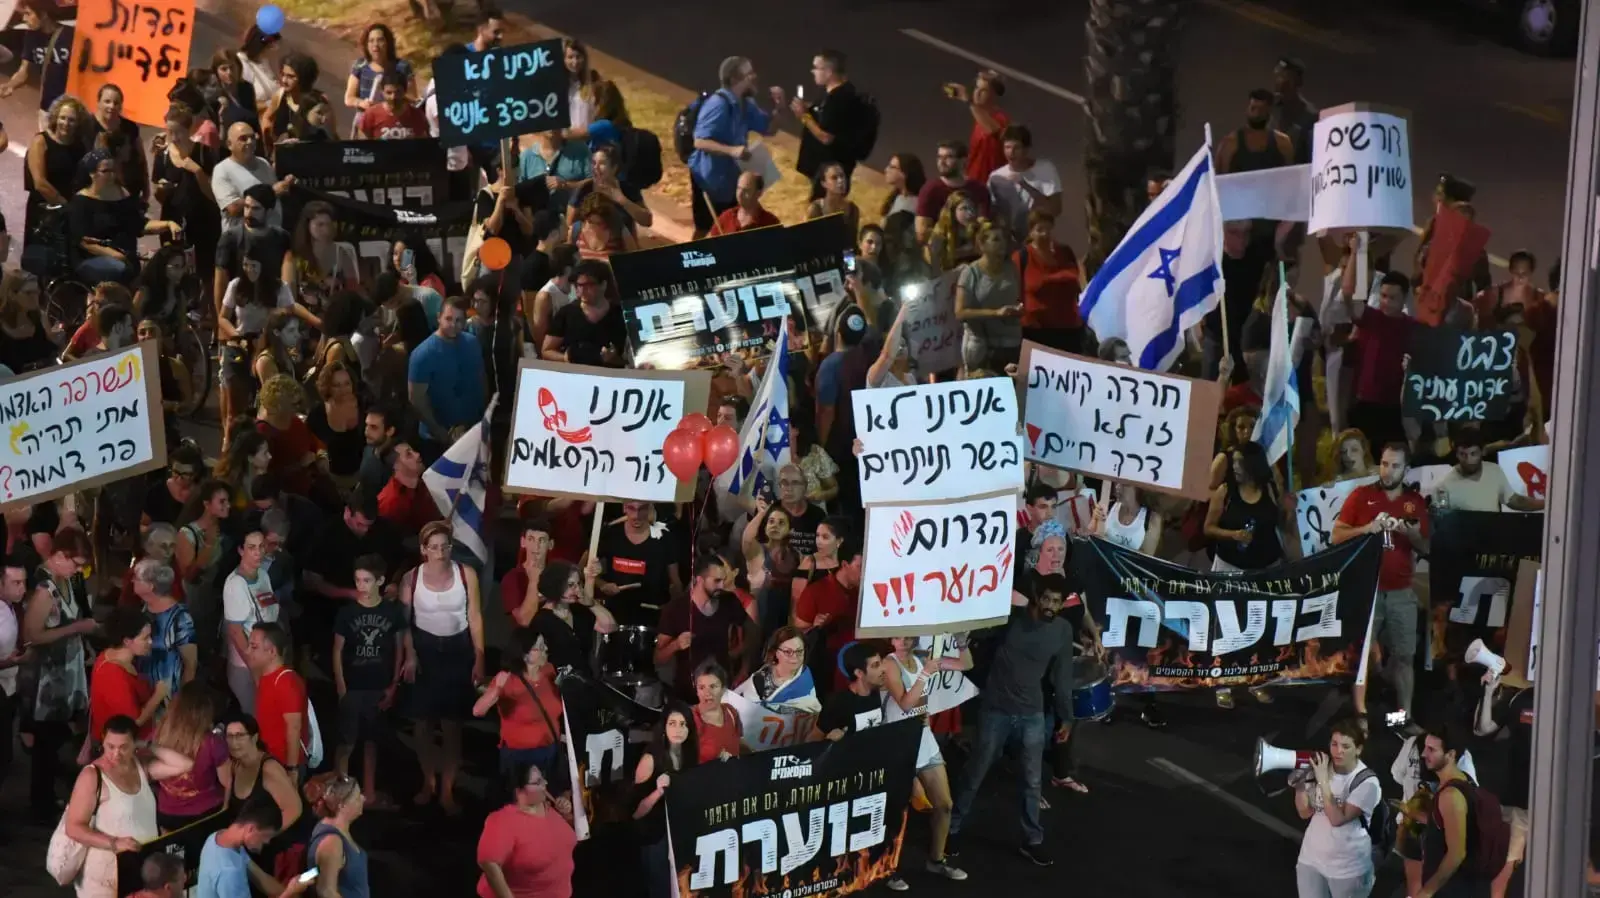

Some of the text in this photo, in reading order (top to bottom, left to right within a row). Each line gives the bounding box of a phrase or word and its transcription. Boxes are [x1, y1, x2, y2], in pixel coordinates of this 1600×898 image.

[464, 47, 554, 80] אנחנו לא
[444, 99, 490, 134] אנושי
[1325, 122, 1401, 157] דורשים
[1457, 332, 1516, 371] צבע
[1028, 366, 1181, 409] חרדה קיומית
[1464, 379, 1508, 403] אדום
[589, 386, 672, 432] אנחנו
[866, 387, 1006, 433] אנחנו לא
[1422, 401, 1487, 421] שחור
[21, 399, 139, 455] מתי תהיה
[1094, 408, 1173, 446] זו לא
[99, 439, 136, 464] פה
[511, 437, 665, 486] דור הקסאמים
[862, 440, 1018, 485] בשר תותחים
[1111, 450, 1163, 482] דרך
[907, 510, 1009, 556] הדרום
[1101, 591, 1342, 657] בוערת
[827, 777, 848, 800] ארץ
[853, 772, 864, 788] לי
[869, 768, 886, 790] אין
[704, 804, 738, 826] אדמתי
[743, 797, 758, 815] אם
[765, 792, 779, 811] גם
[690, 791, 888, 890] בוערת
